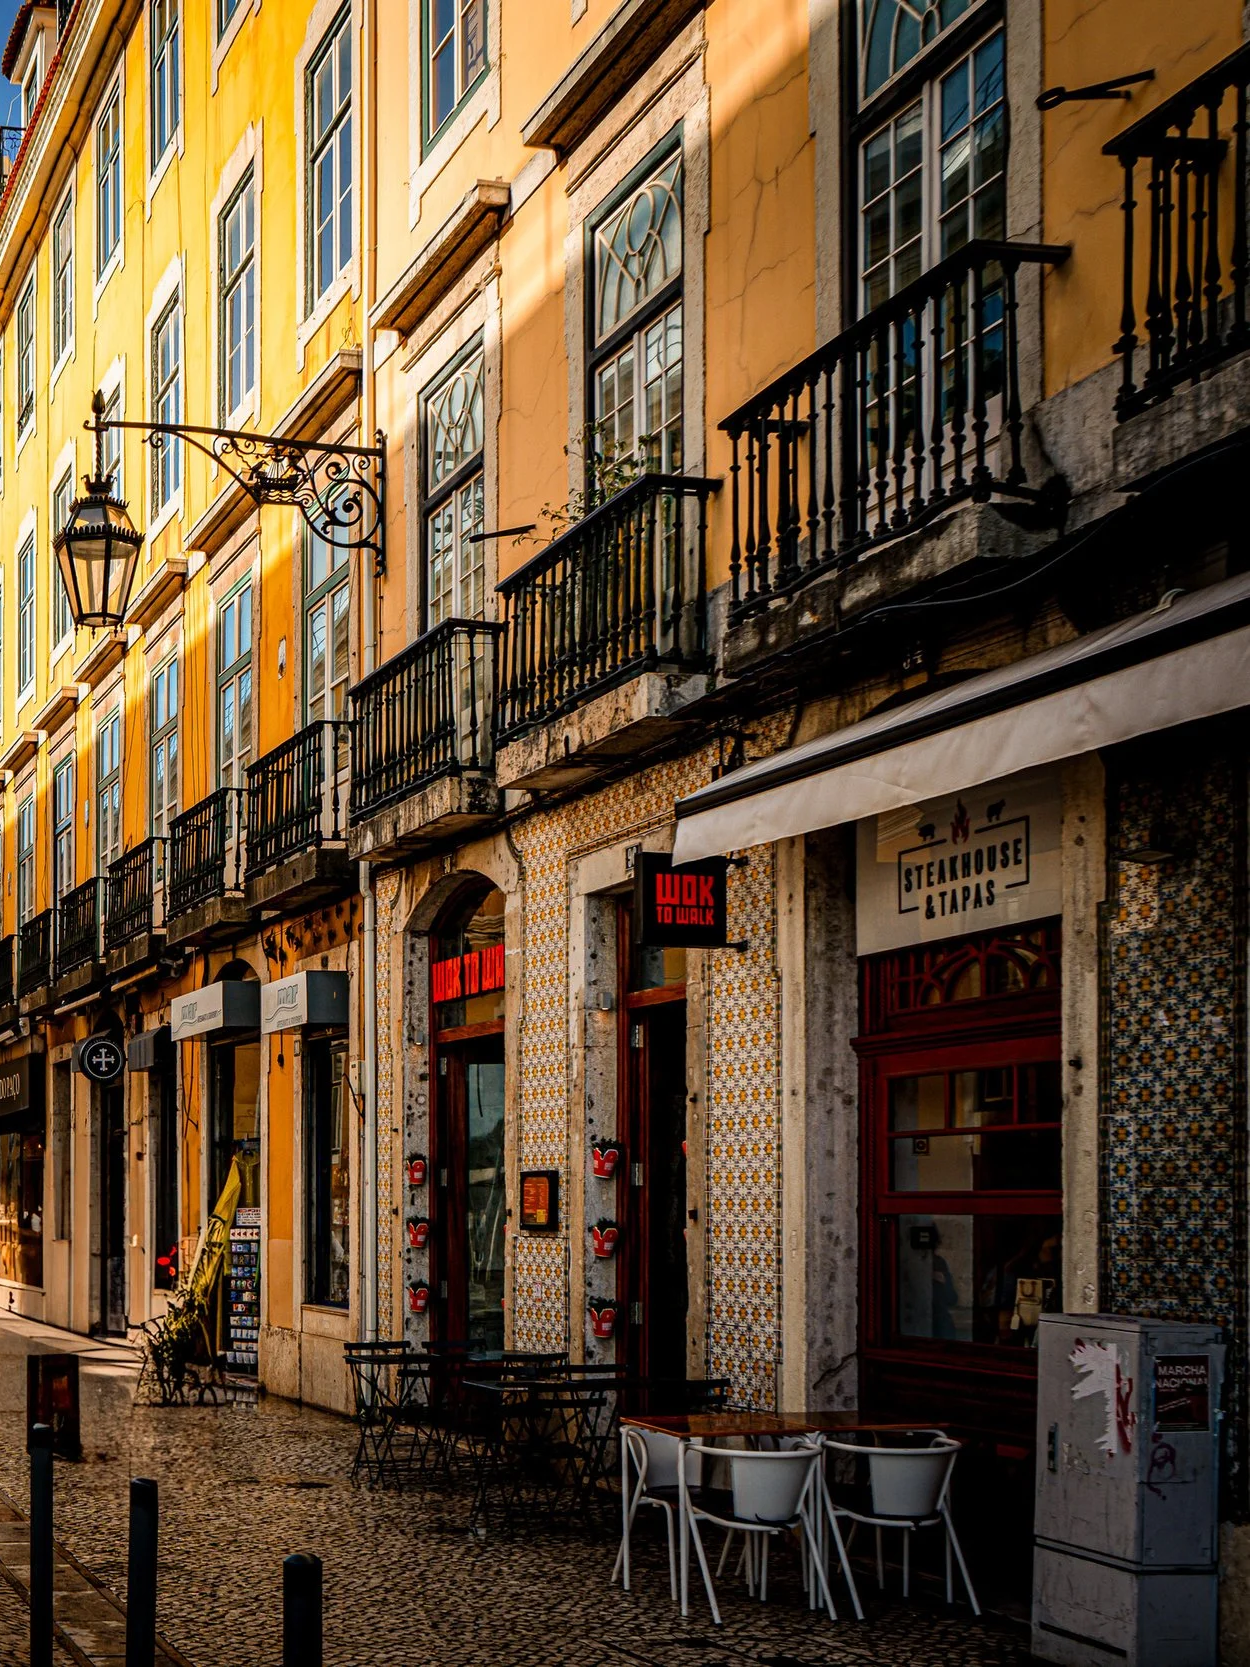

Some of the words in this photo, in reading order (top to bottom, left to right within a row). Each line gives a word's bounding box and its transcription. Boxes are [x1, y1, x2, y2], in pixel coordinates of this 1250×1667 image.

[903, 837, 1023, 894] STEAKHOUSE
[656, 873, 714, 906] WOK
[656, 905, 673, 924] TO
[676, 906, 714, 925] WALK
[432, 956, 461, 1003] WOK
[463, 951, 479, 995] TO
[1158, 1365, 1207, 1376] MARCHA
